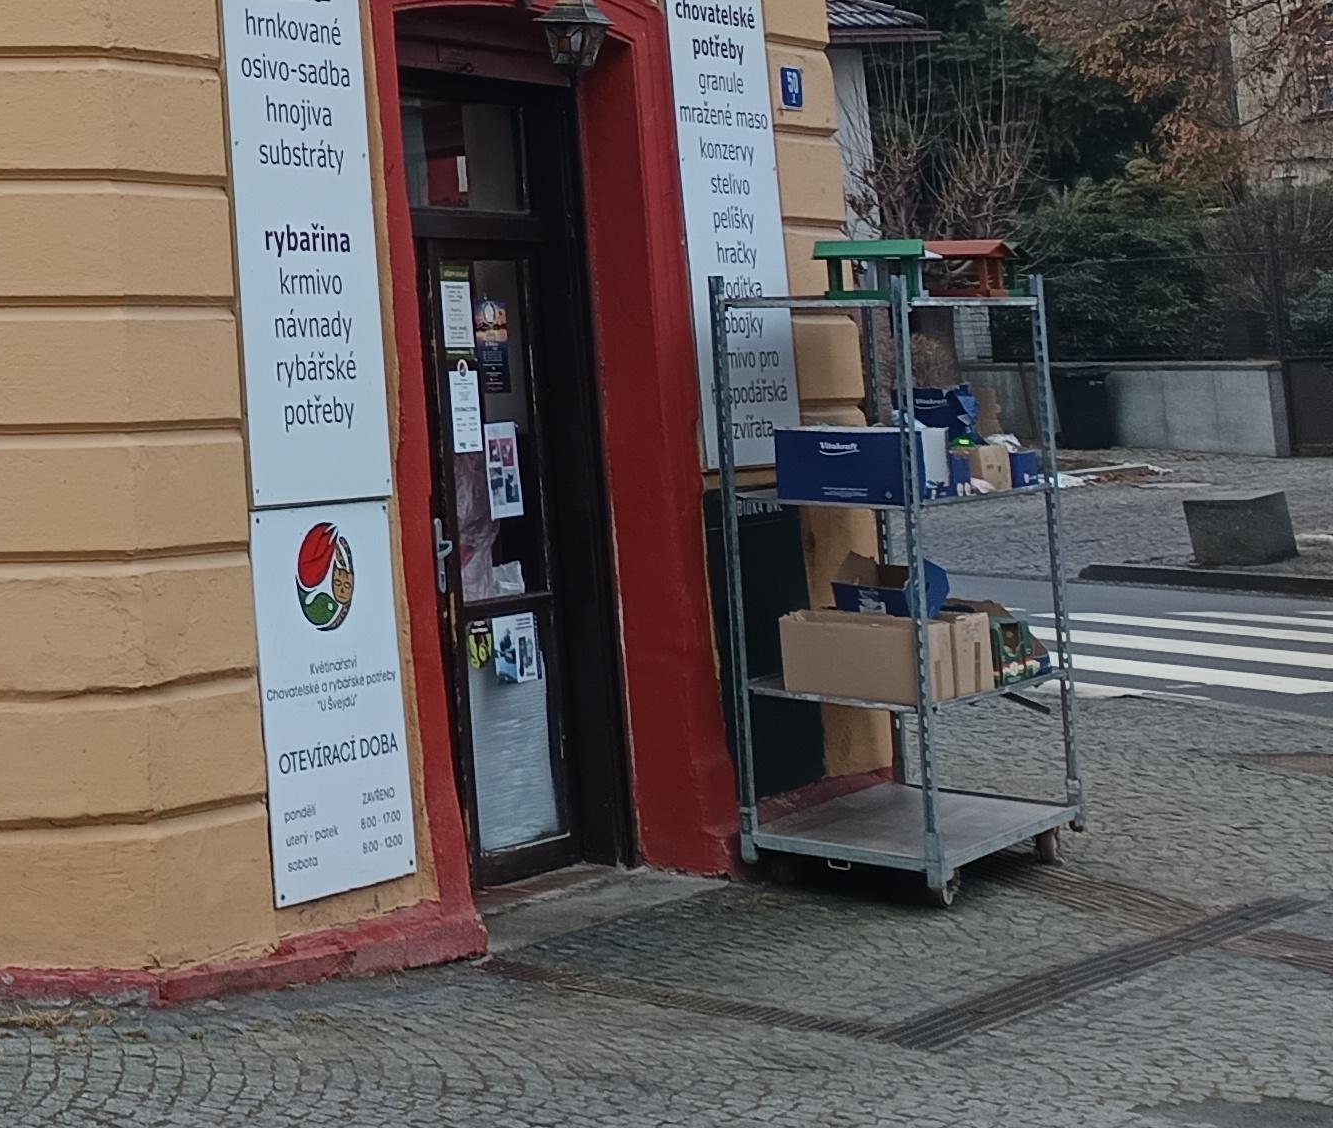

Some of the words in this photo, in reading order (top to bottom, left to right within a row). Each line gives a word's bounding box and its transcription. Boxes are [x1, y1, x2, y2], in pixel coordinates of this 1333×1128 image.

[245, 8, 342, 46] hrnkované
[693, 34, 744, 65] potřeby
[241, 53, 350, 87] osivo-sadba
[699, 72, 744, 95] granule
[786, 71, 799, 94] 50
[266, 95, 332, 131] hnojiva
[679, 102, 733, 127] mražené
[736, 111, 768, 130] maso
[259, 139, 344, 175] substráty
[700, 137, 754, 166] konzervy
[711, 173, 750, 196] stelivo
[713, 206, 754, 234] pelíšky
[265, 223, 351, 258] rybařina
[717, 240, 757, 269] hračky
[279, 267, 342, 295] krmivo
[725, 274, 762, 298] odítka
[274, 309, 352, 344] návnady
[276, 351, 357, 388] rybářské
[726, 347, 756, 369] mivo
[760, 350, 780, 373] pro
[711, 377, 788, 410] hspodářská
[284, 395, 354, 432] potřeby
[732, 414, 773, 440] zvířata
[266, 682, 319, 701] Chovatelské
[329, 674, 364, 693] rybářské
[367, 670, 396, 687] potřeby
[279, 734, 357, 774] OTEVÍRACÍ
[360, 732, 399, 759] DOBA
[284, 804, 316, 823] pondělí
[362, 786, 395, 805] ZAVŘENO
[288, 857, 318, 872] sobota
